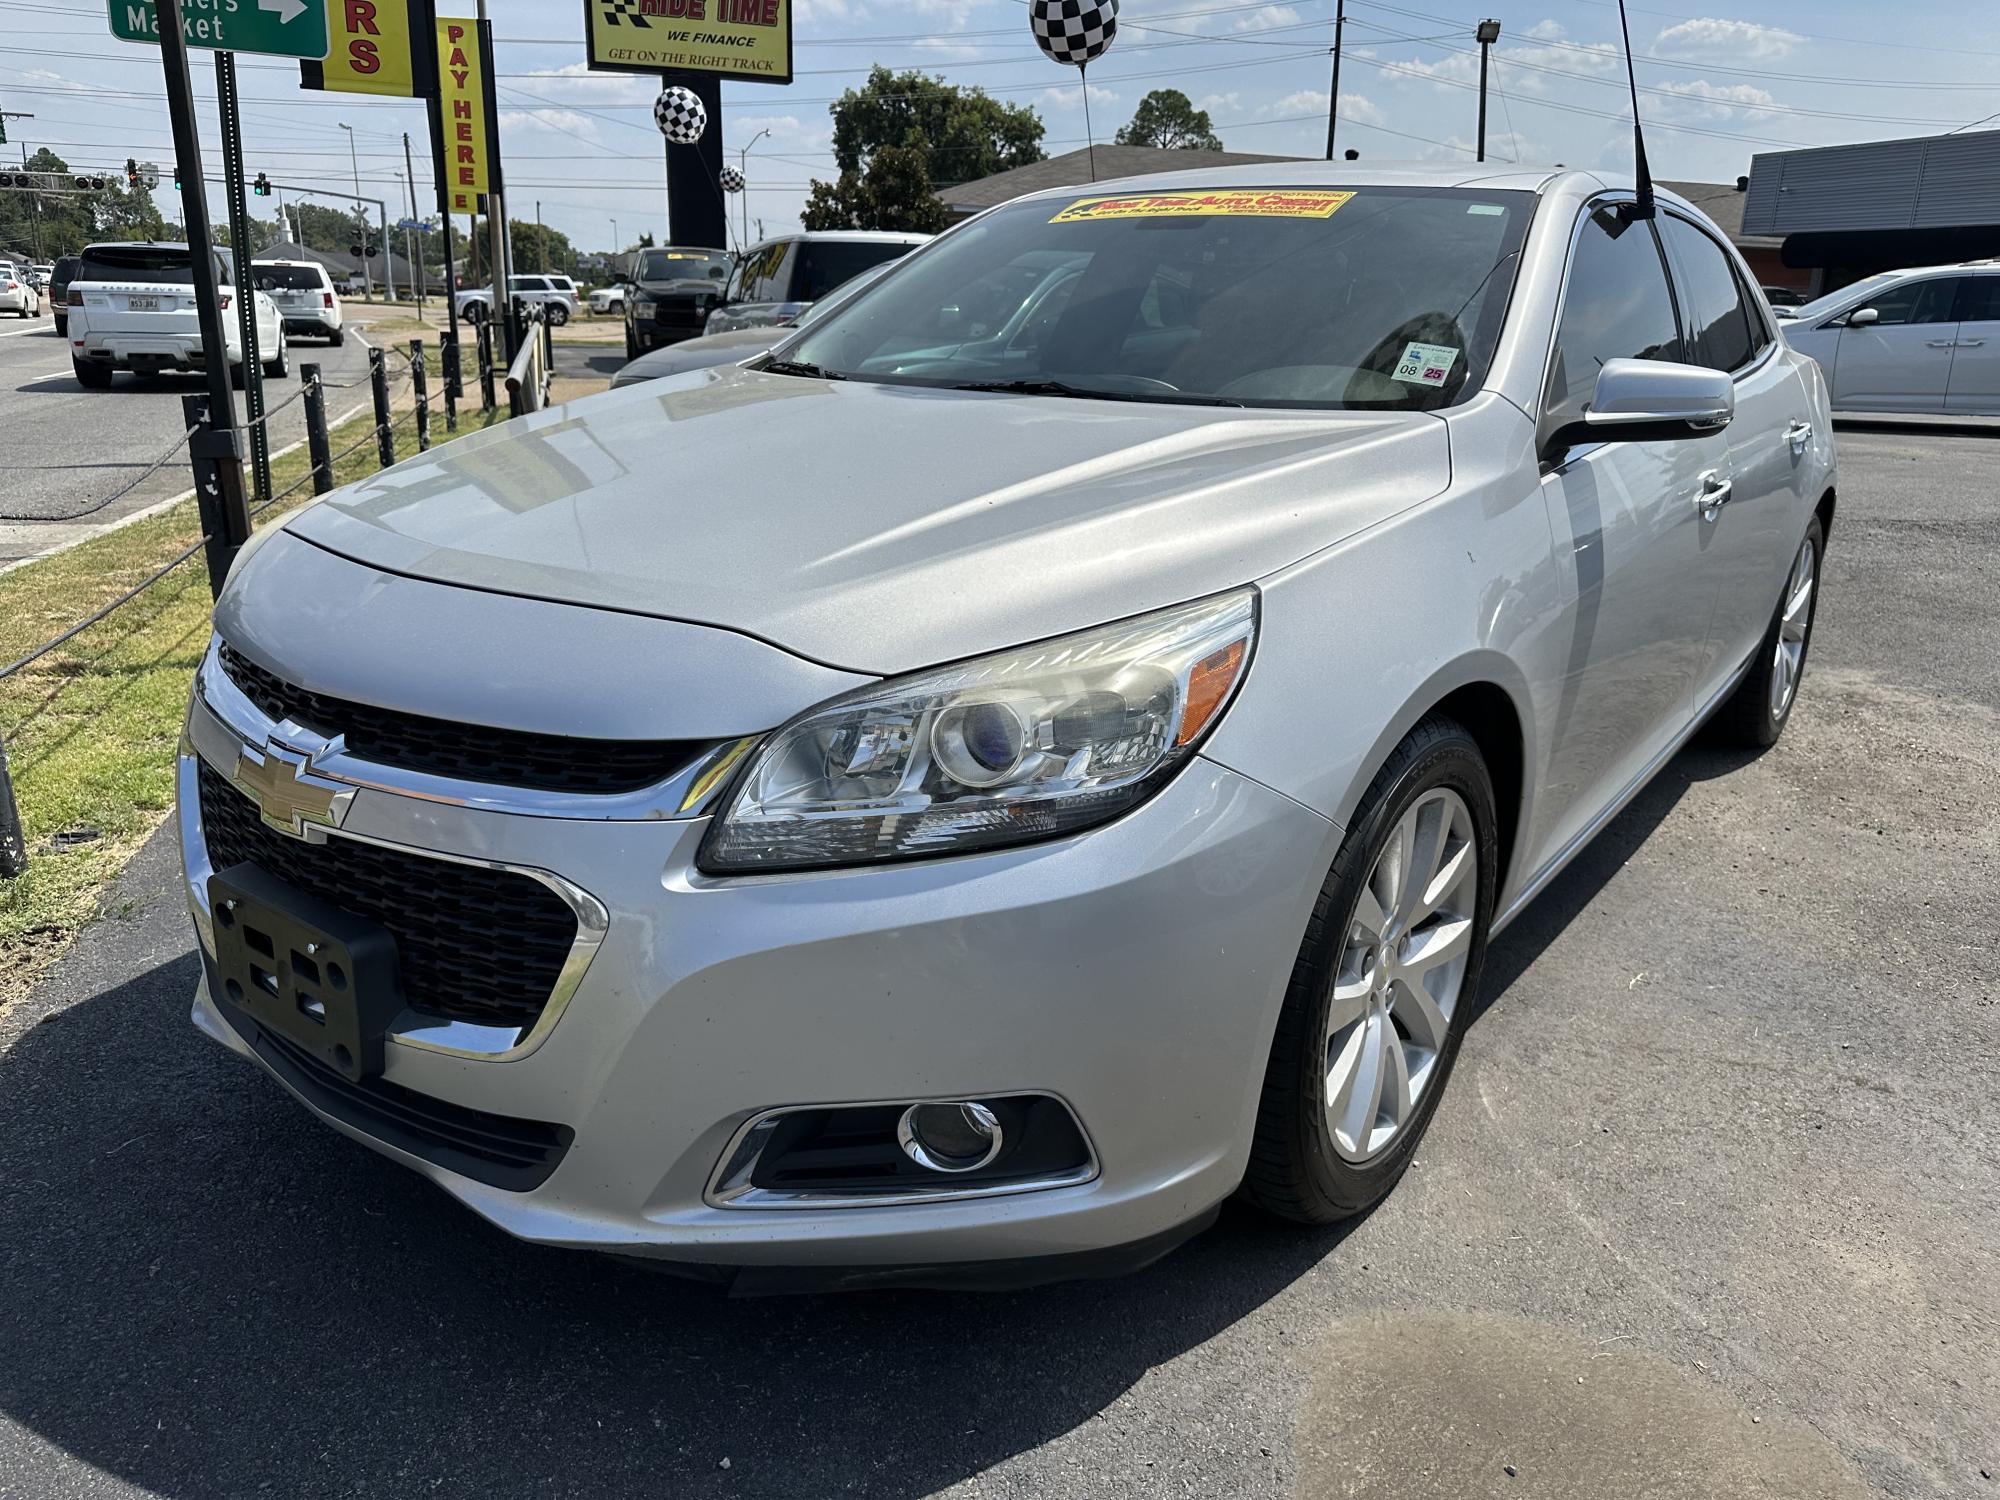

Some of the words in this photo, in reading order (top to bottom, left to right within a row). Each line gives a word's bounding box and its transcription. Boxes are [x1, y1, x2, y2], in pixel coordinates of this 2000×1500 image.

[127, 5, 224, 40] Maket
[667, 30, 690, 43] WE
[692, 33, 757, 47] FINANCE
[447, 25, 469, 89] PAY
[608, 48, 633, 60] GET
[636, 51, 657, 63] ON
[660, 52, 685, 64] THE
[688, 55, 729, 68] RIGHT
[731, 57, 775, 71] TRACK
[453, 100, 475, 186] HERE
[1400, 364, 1418, 376] 08
[1424, 368, 1443, 379] 25
